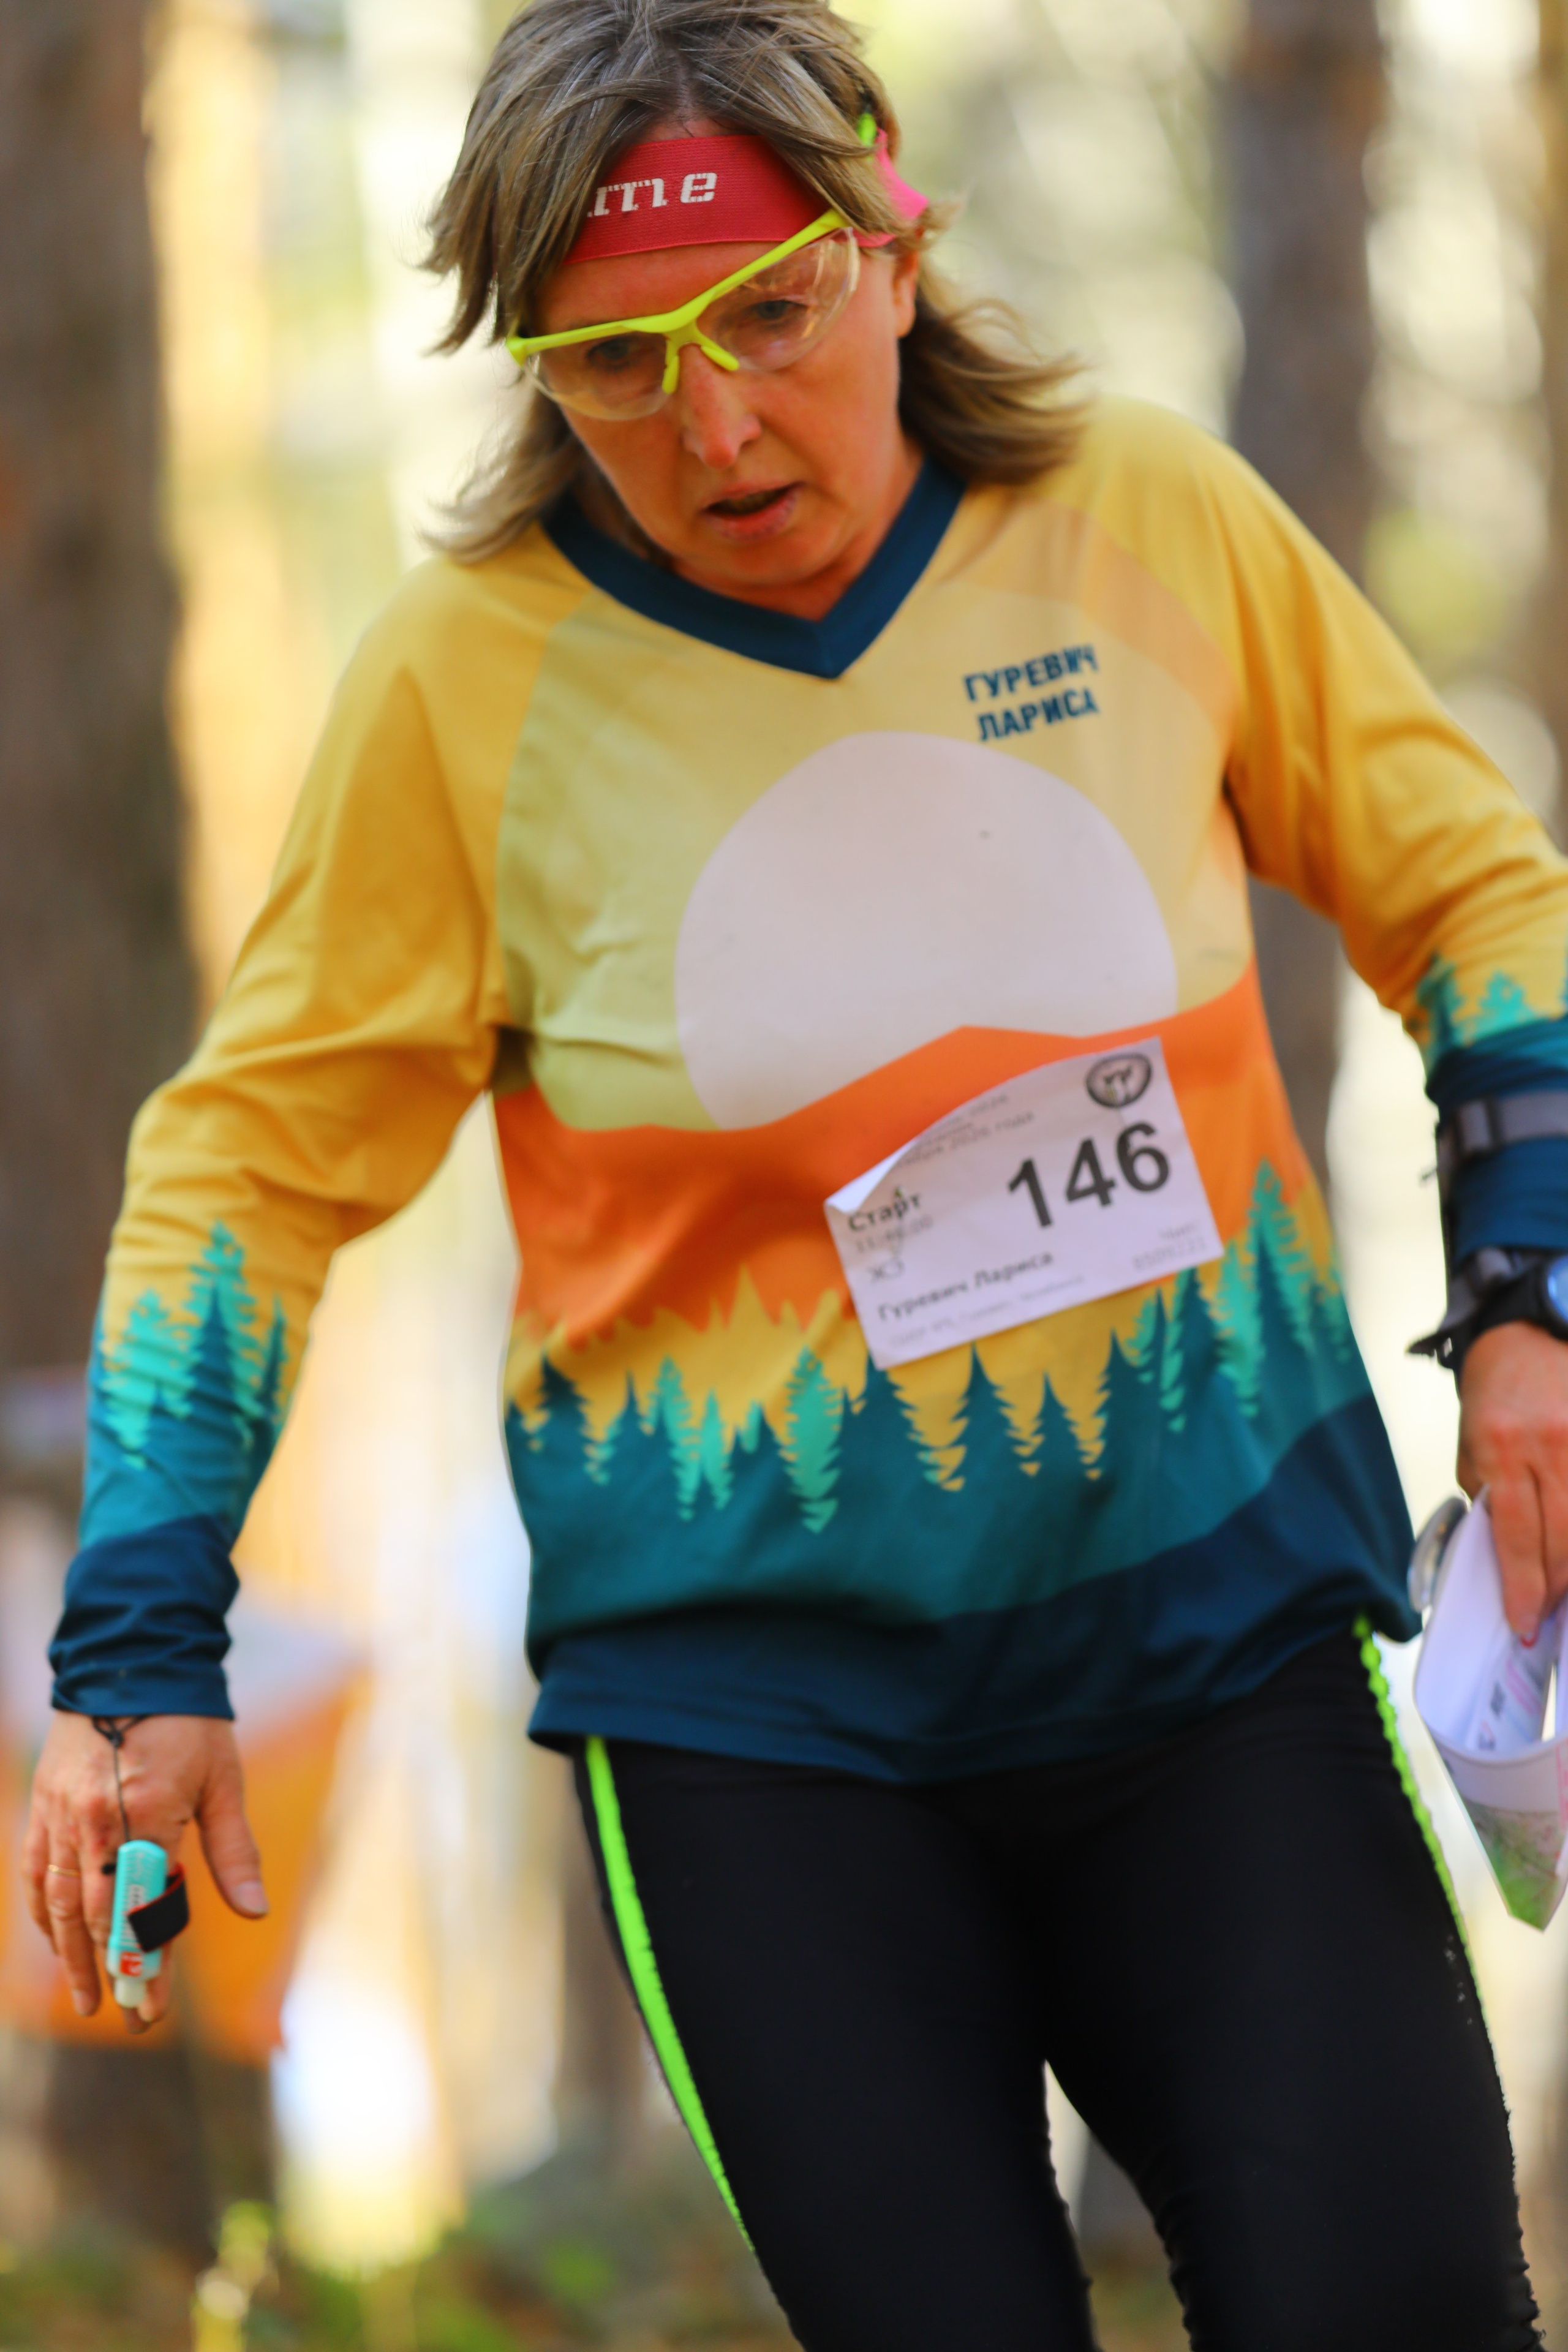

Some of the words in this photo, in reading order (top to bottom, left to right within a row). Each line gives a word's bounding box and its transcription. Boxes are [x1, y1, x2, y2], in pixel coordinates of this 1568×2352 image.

[587, 172, 718, 217] me
[963, 645, 1098, 702] ГУРЕВИЧ
[978, 688, 1099, 742] ЛАРИСА
[1007, 1121, 1171, 1229] 146
[848, 1194, 921, 1232] Старт
[878, 1280, 969, 1322] Гуревич
[974, 1251, 1054, 1288] Лариса
